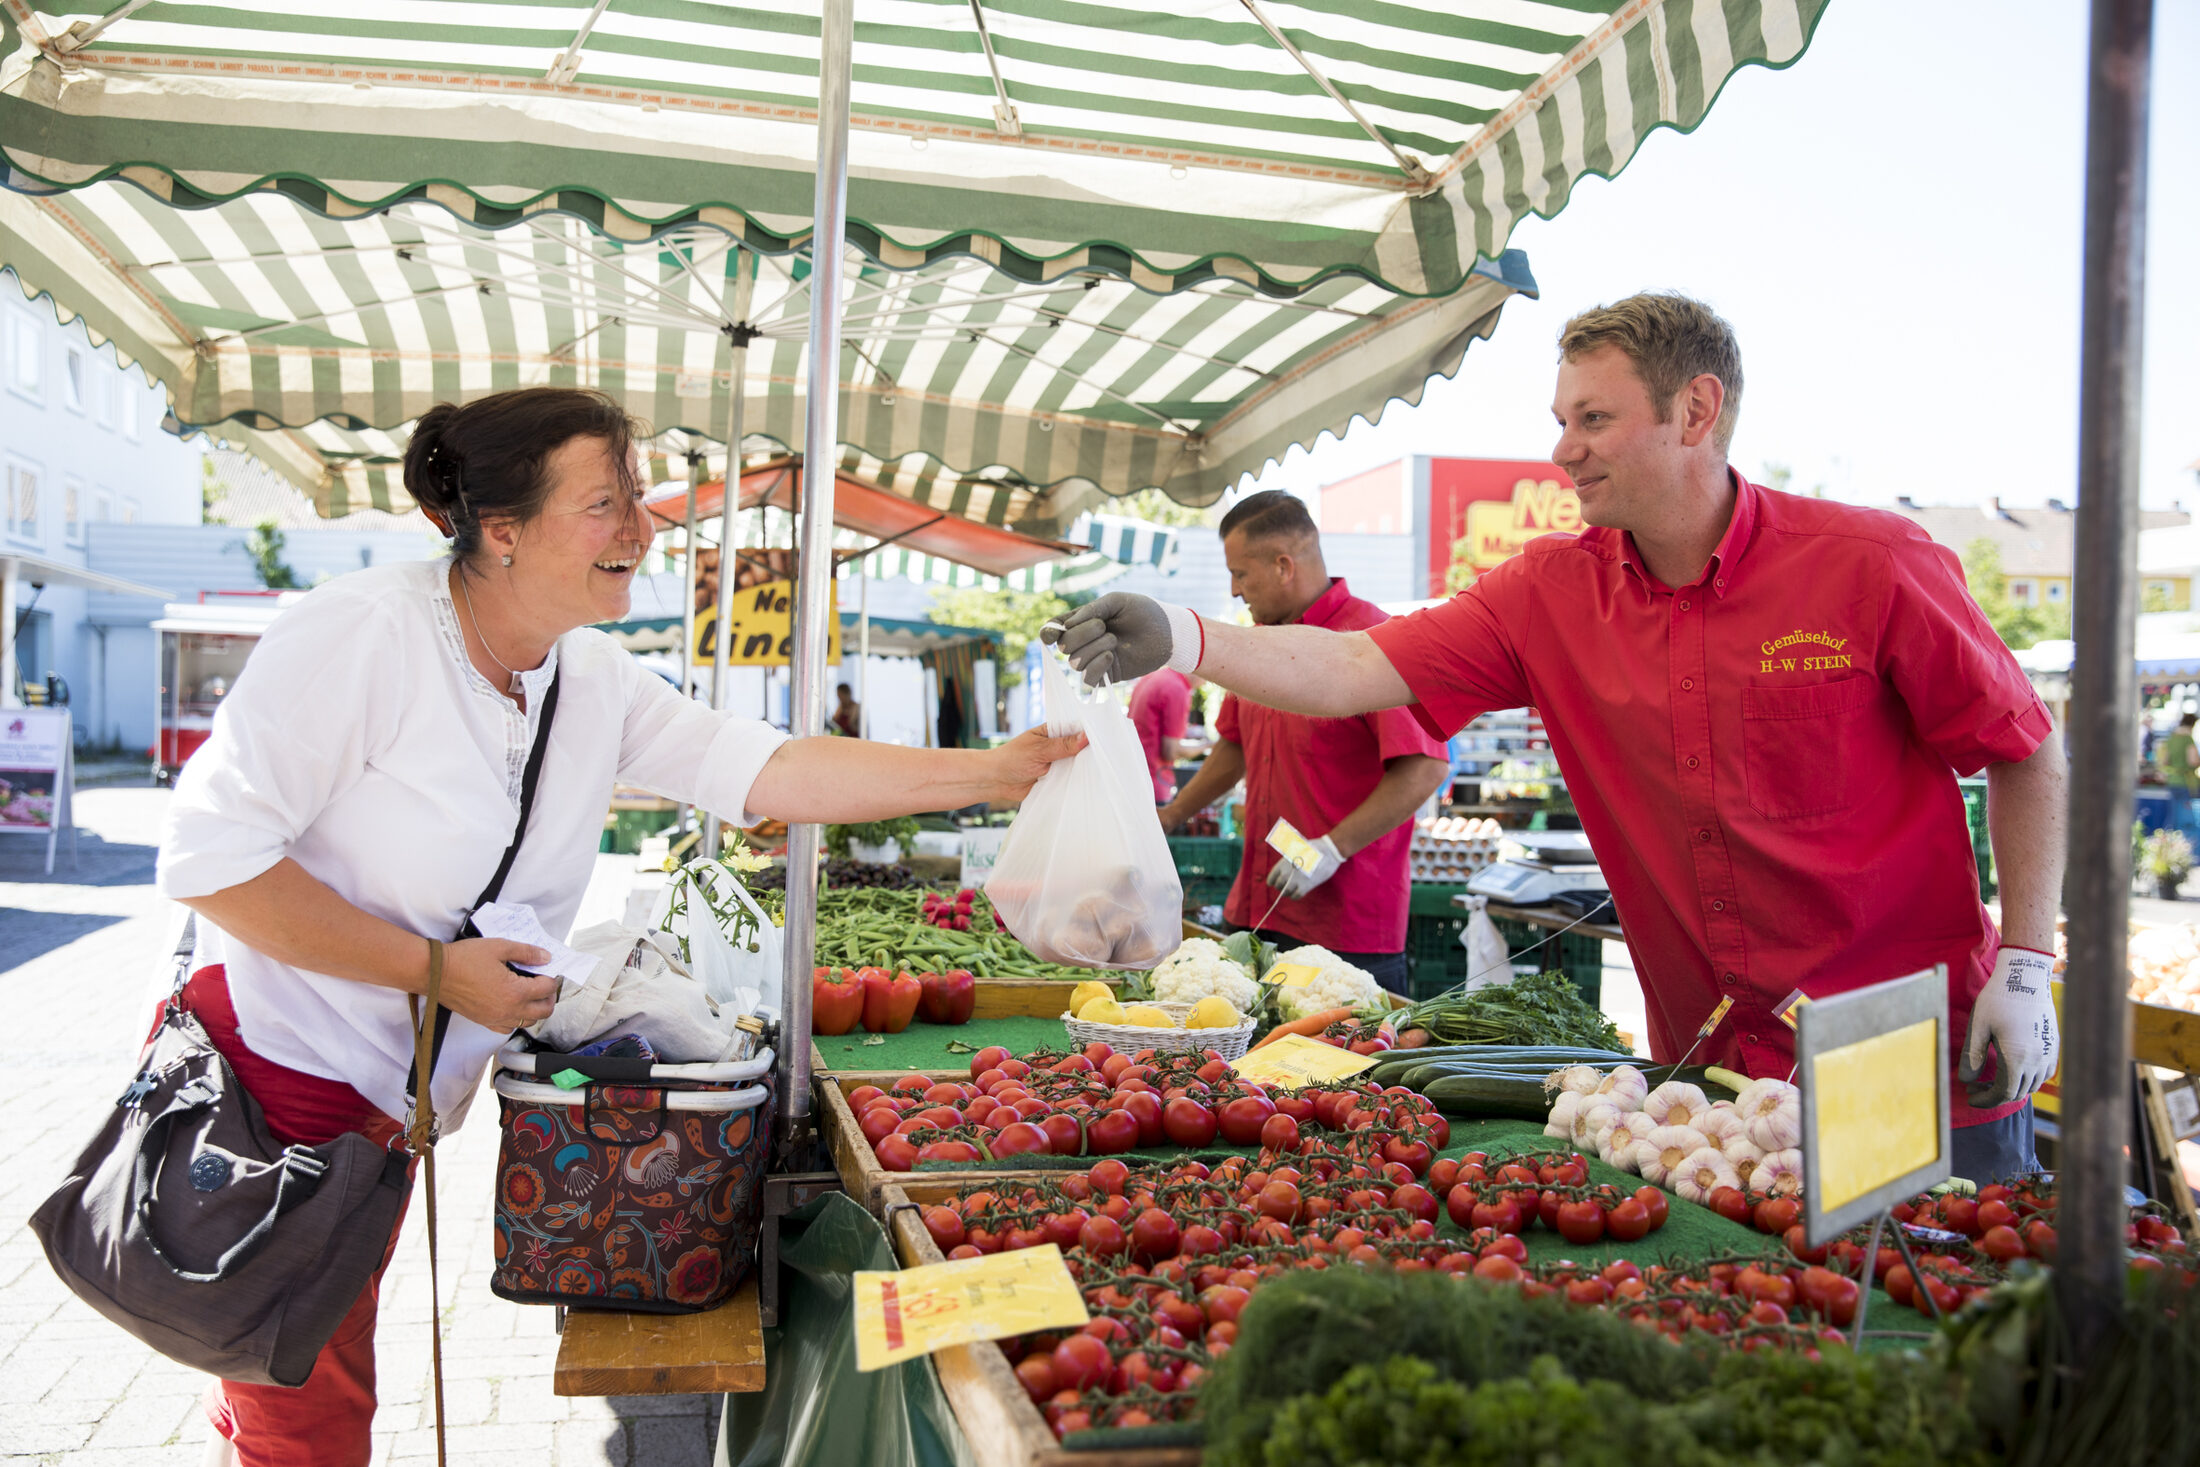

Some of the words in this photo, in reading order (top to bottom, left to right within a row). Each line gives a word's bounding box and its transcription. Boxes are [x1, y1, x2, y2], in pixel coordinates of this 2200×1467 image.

[1761, 630, 1848, 655] Gemüsehof
[1760, 659, 1797, 673] H-W
[1804, 654, 1852, 671] STEIN
[2008, 985, 2036, 995] Ansell
